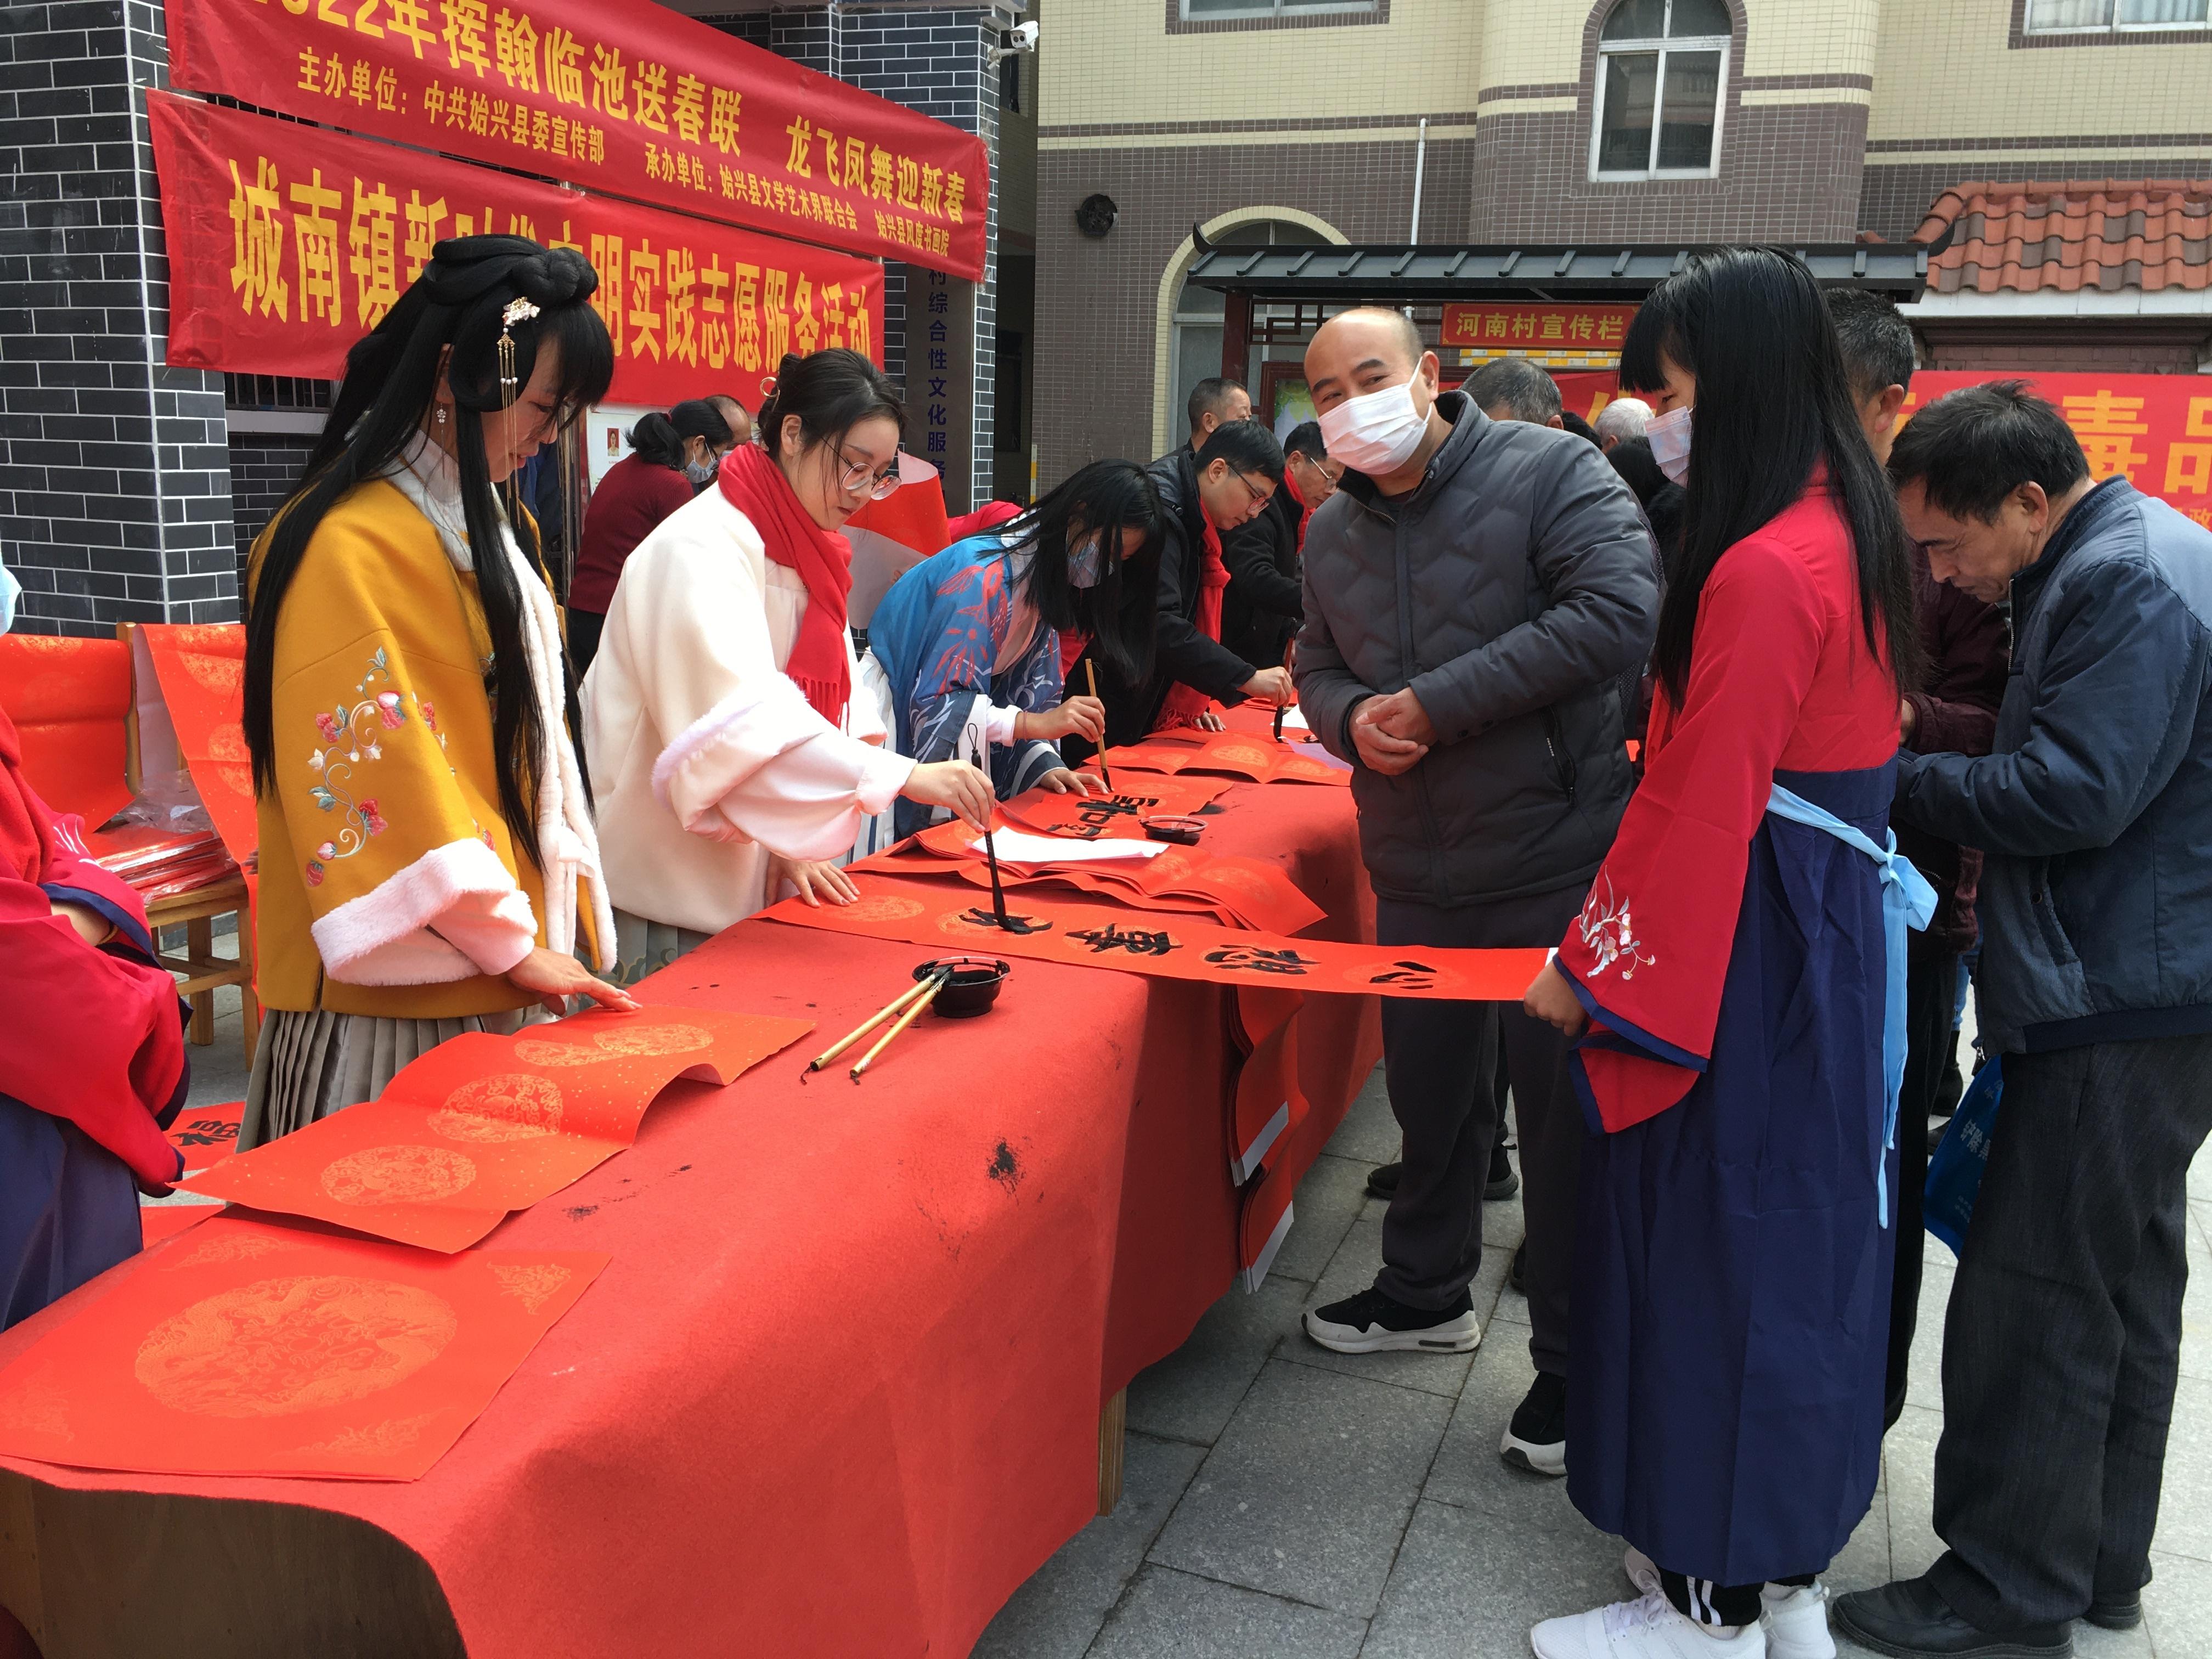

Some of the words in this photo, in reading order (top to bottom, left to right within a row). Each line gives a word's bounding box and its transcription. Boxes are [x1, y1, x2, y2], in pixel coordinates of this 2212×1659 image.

[297, 46, 605, 166] 主办单位：中共始兴县委宣传部
[645, 142, 857, 232] 承办单位：始兴县文学艺术界联合会
[874, 209, 950, 257] 始兴县风度书画院
[786, 115, 966, 224] 龙飞凤舞迎新春
[229, 156, 872, 374] 城南镇新明实践志愿服务活动
[1456, 312, 1623, 340] 河南村宣传栏
